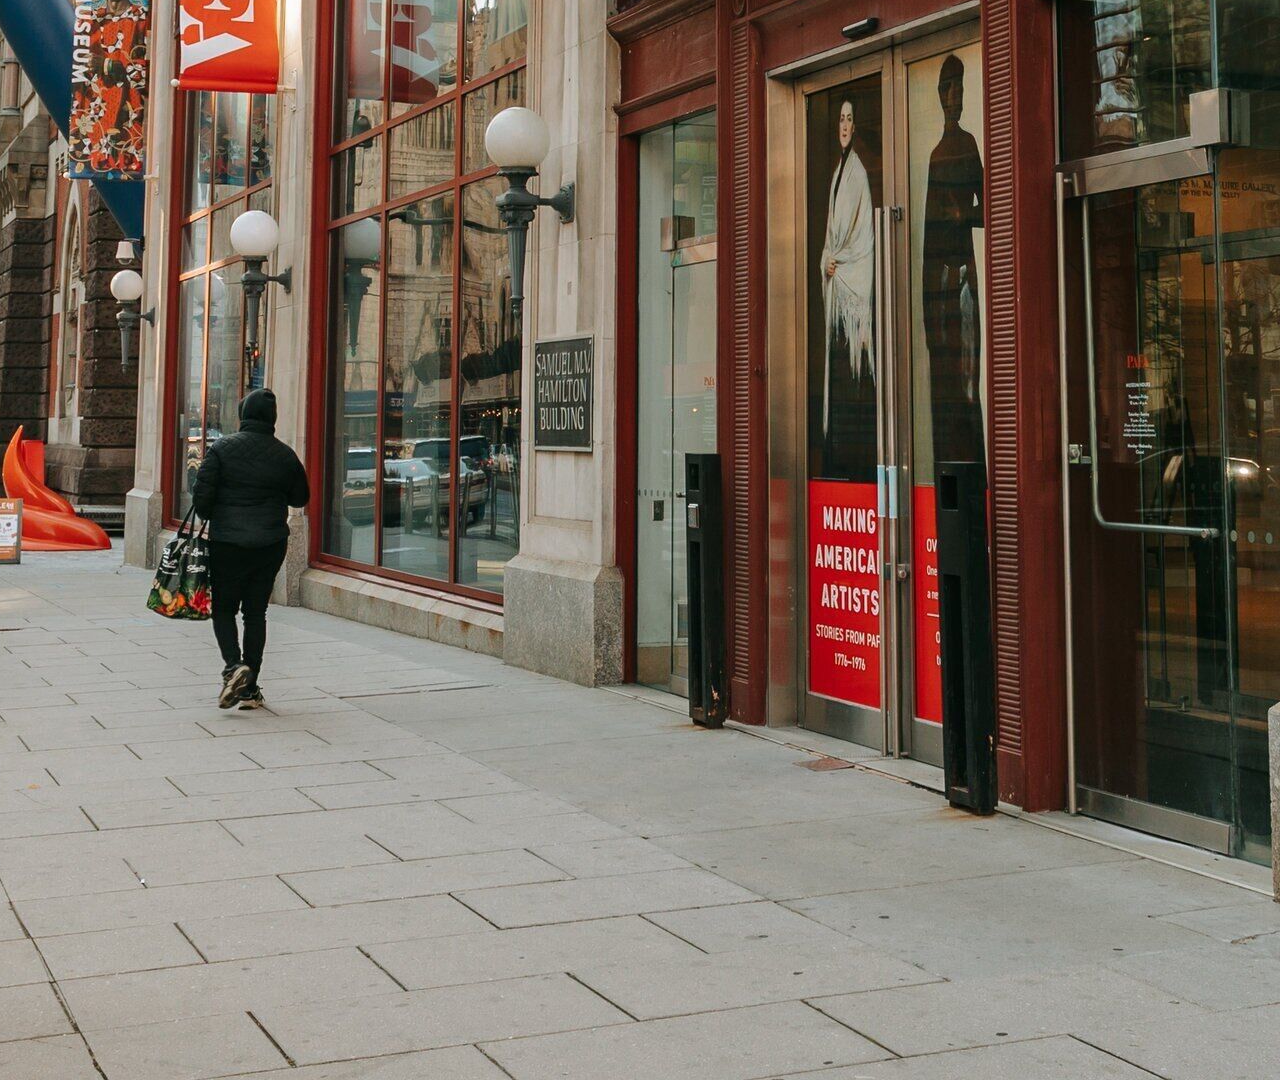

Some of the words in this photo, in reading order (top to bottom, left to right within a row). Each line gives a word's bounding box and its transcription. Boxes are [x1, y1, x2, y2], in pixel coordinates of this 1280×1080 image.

[536, 352, 573, 376] SAMUEL
[538, 378, 587, 402] HAMILTON
[540, 406, 584, 430] BUILDING
[823, 506, 876, 534] MAKING
[815, 544, 879, 575] AMERICA
[821, 583, 880, 616] ARTISTS
[816, 624, 843, 642] STORIES
[845, 629, 865, 645] FROM
[866, 634, 880, 648] PAF
